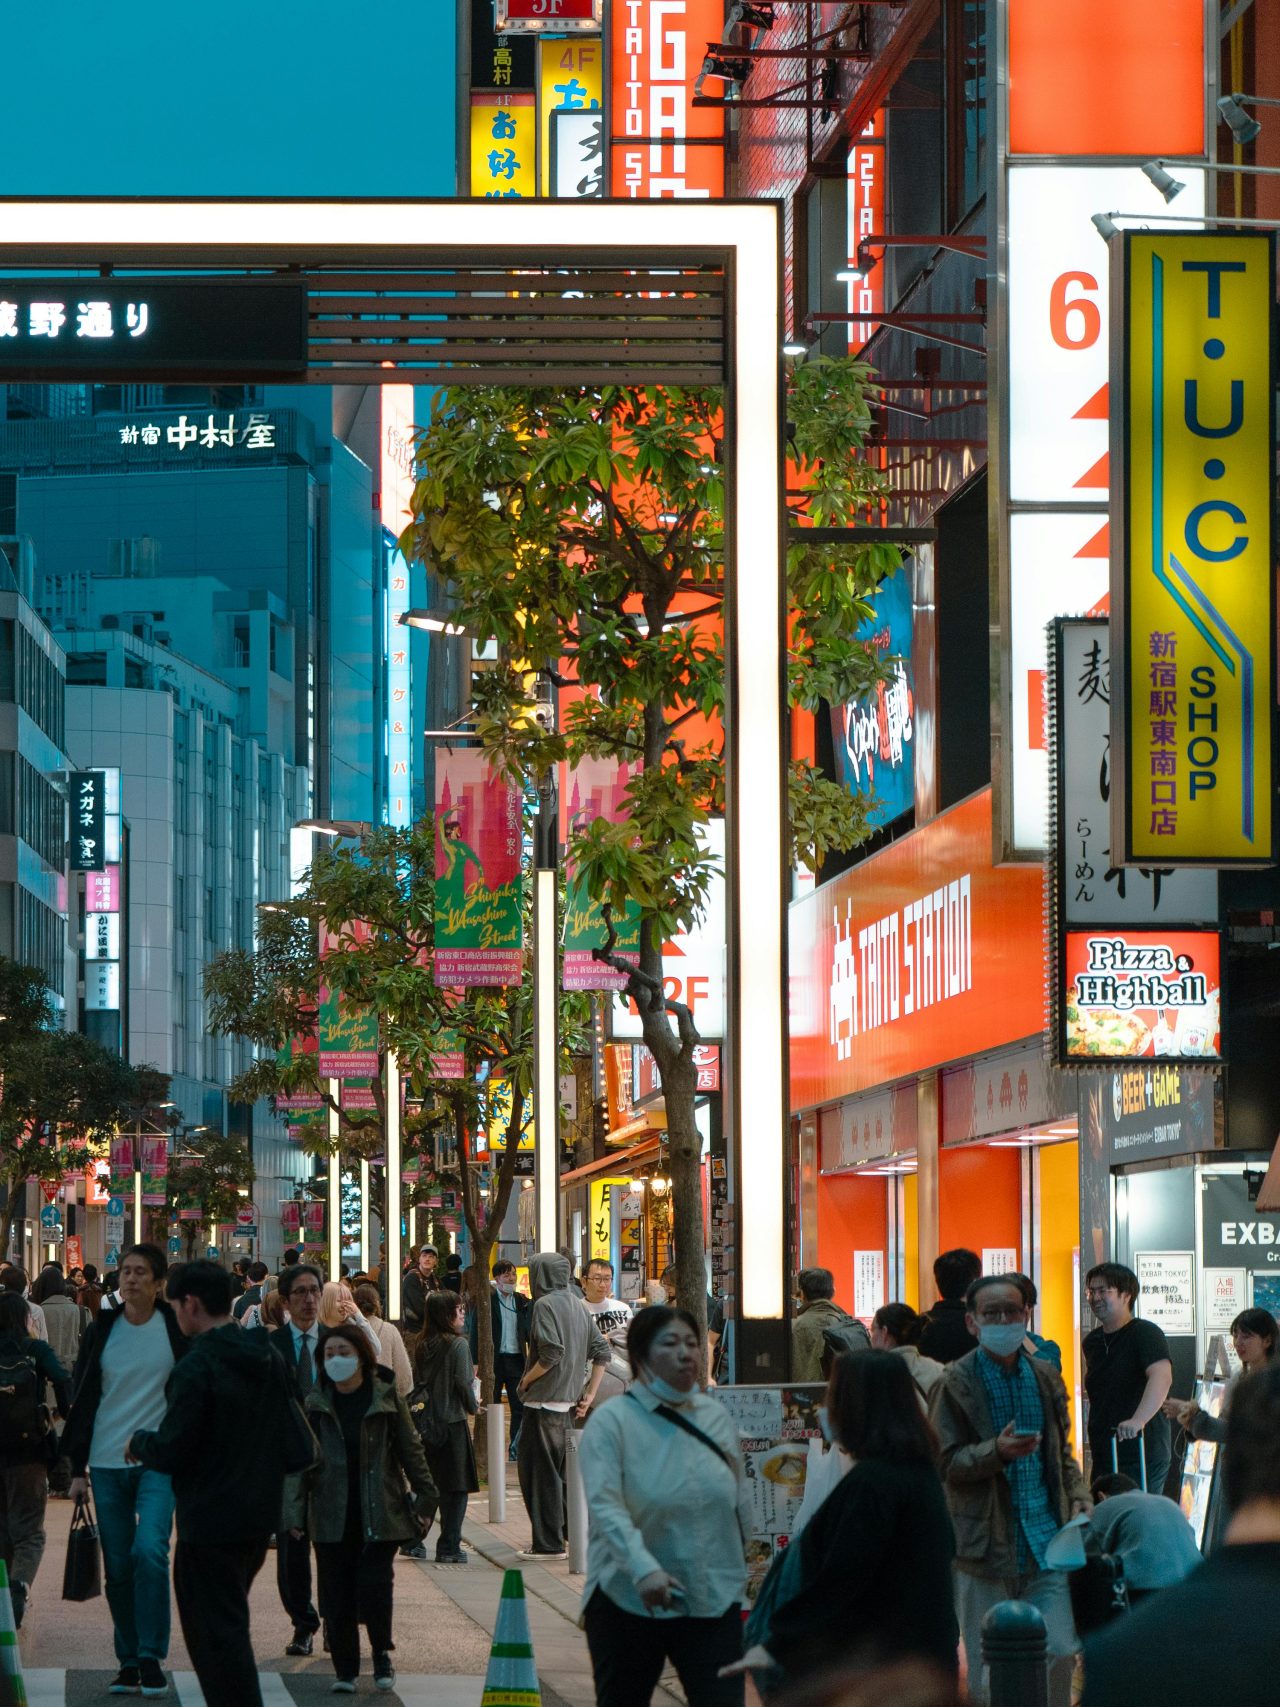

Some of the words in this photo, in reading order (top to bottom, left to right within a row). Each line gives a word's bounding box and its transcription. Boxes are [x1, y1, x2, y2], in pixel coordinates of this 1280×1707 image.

[493, 48, 512, 85] 高村
[559, 48, 595, 71] 4F
[626, 1, 642, 135] TAITO
[495, 95, 513, 106] 4F
[650, 1, 709, 197] GA
[486, 111, 521, 197] お好
[1149, 631, 1177, 836] 新宿駅東南口店
[1187, 666, 1219, 801] SHOP
[79, 780, 95, 827] メガネ
[1075, 819, 1095, 903] らーめん
[479, 924, 519, 950] Street
[859, 911, 900, 1033] TAITO
[904, 873, 972, 1015] STATION
[1089, 940, 1174, 971] Pizza
[1177, 955, 1190, 972] &
[1077, 975, 1207, 1009] Highball
[1266, 1252, 1280, 1262] Cr
[1216, 1288, 1234, 1296] FREE
